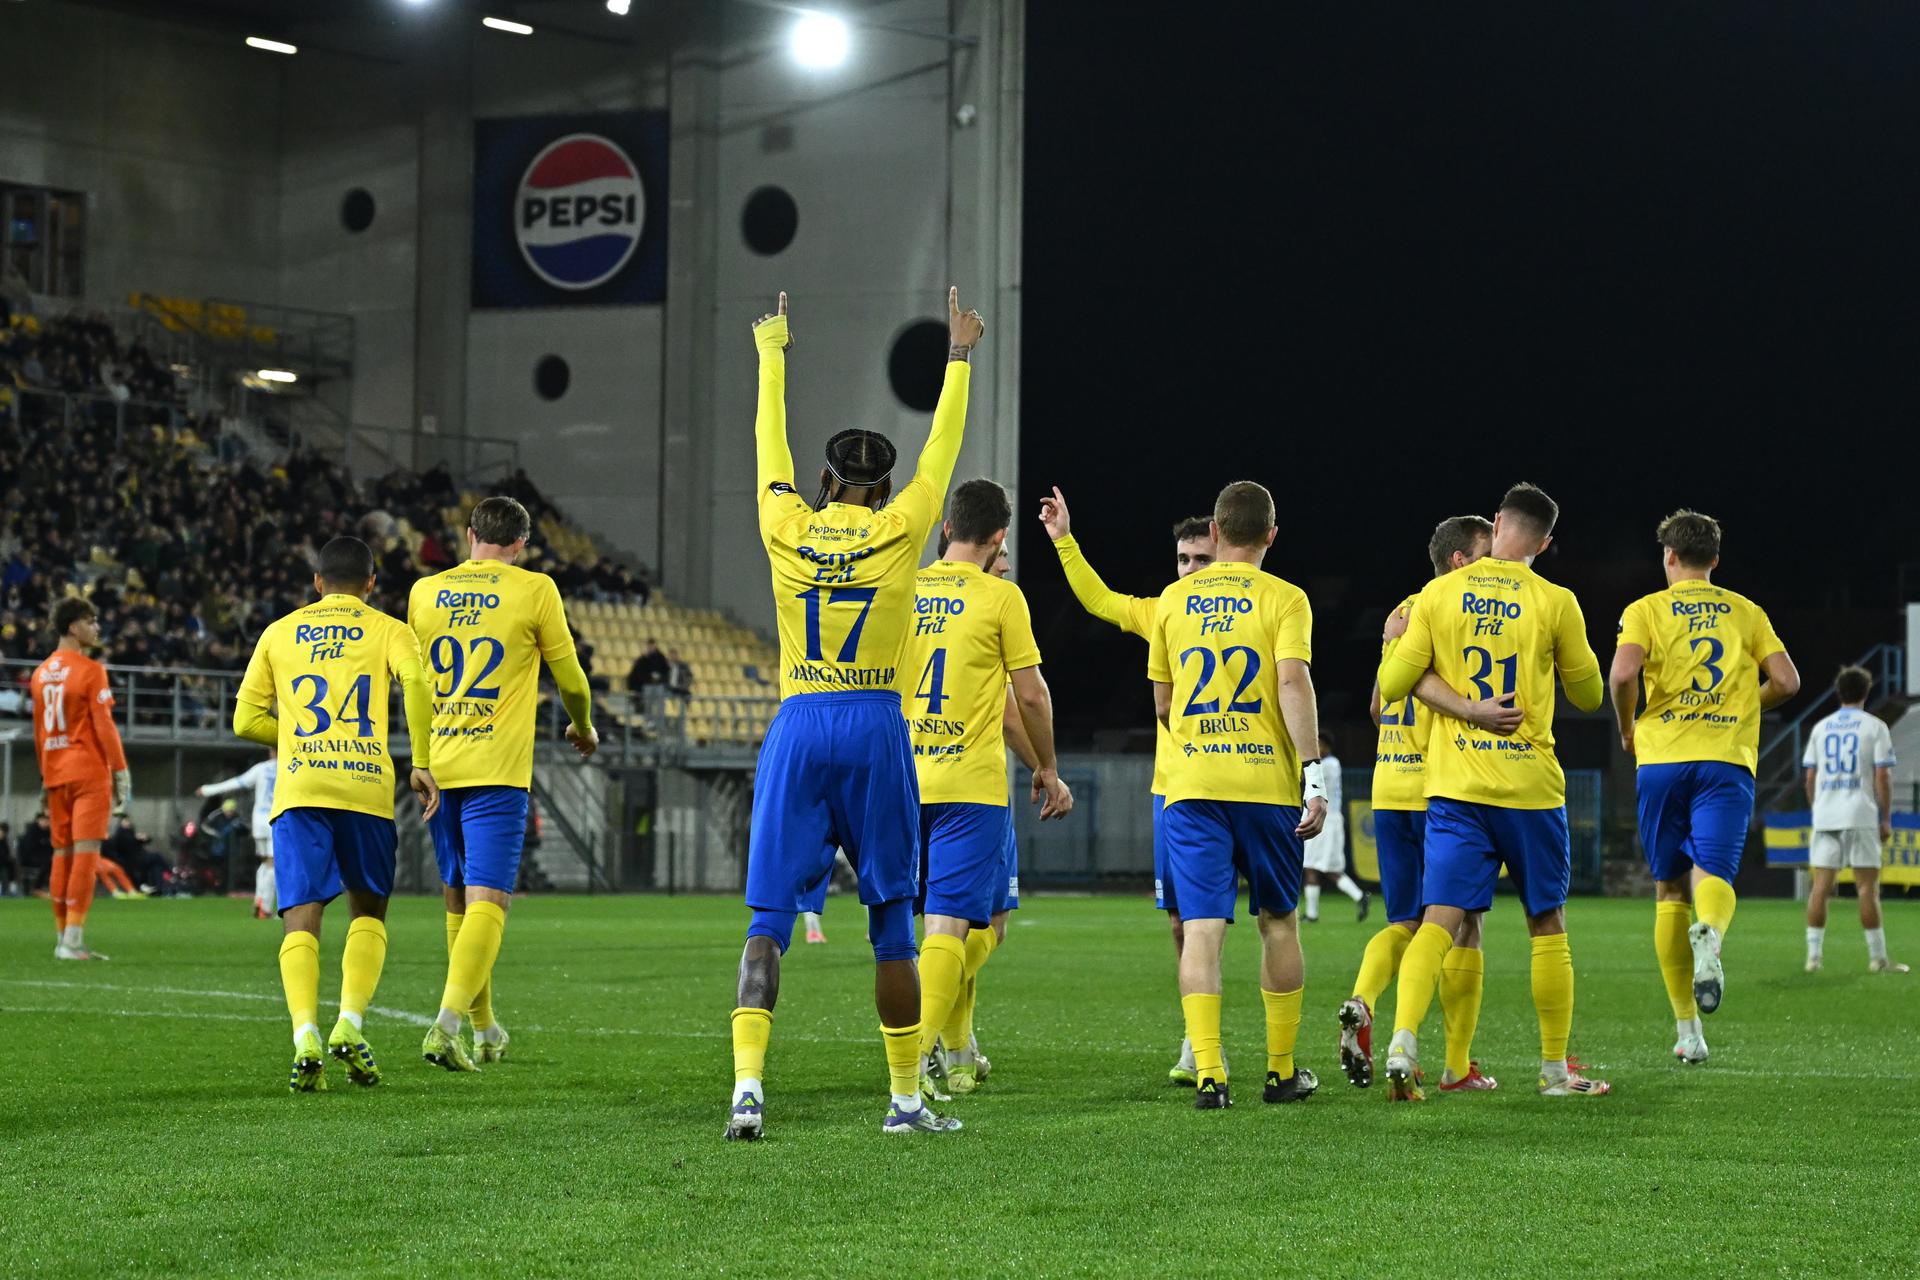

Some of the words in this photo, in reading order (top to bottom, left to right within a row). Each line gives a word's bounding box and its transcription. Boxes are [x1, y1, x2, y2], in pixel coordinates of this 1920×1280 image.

[523, 193, 635, 229] PEPSI
[808, 524, 858, 537] PepperMill
[814, 565, 856, 584] Frit
[916, 575, 956, 583] epperMill
[1193, 576, 1241, 585] PepperMill
[1468, 575, 1511, 585] PepperMill
[436, 589, 500, 609] Remo
[1186, 595, 1253, 615] Remo
[1463, 592, 1521, 619] Remo
[1672, 601, 1731, 616] Remo
[448, 609, 481, 629] Frit
[795, 586, 879, 663] 17
[915, 616, 947, 636] Frit
[1200, 615, 1235, 636] Frit
[1474, 617, 1504, 636] Frit
[1689, 614, 1718, 633] Frit
[296, 624, 364, 645] Remo
[310, 641, 344, 663] Frit
[430, 635, 505, 700] 92
[1690, 637, 1724, 692] 3
[915, 648, 949, 714] 4
[1180, 646, 1262, 717] 22
[1463, 646, 1517, 708] 31
[291, 674, 376, 738] 34
[1200, 714, 1249, 734] BRÜLS
[292, 740, 382, 756] ABRAHAMS
[1203, 743, 1231, 753] VAN
[1236, 743, 1274, 755] MOER
[1825, 733, 1858, 774] 93
[308, 760, 338, 769] VAN
[343, 761, 382, 775] MOER
[1244, 756, 1275, 765] Logistics
[352, 773, 382, 784] Logistics
